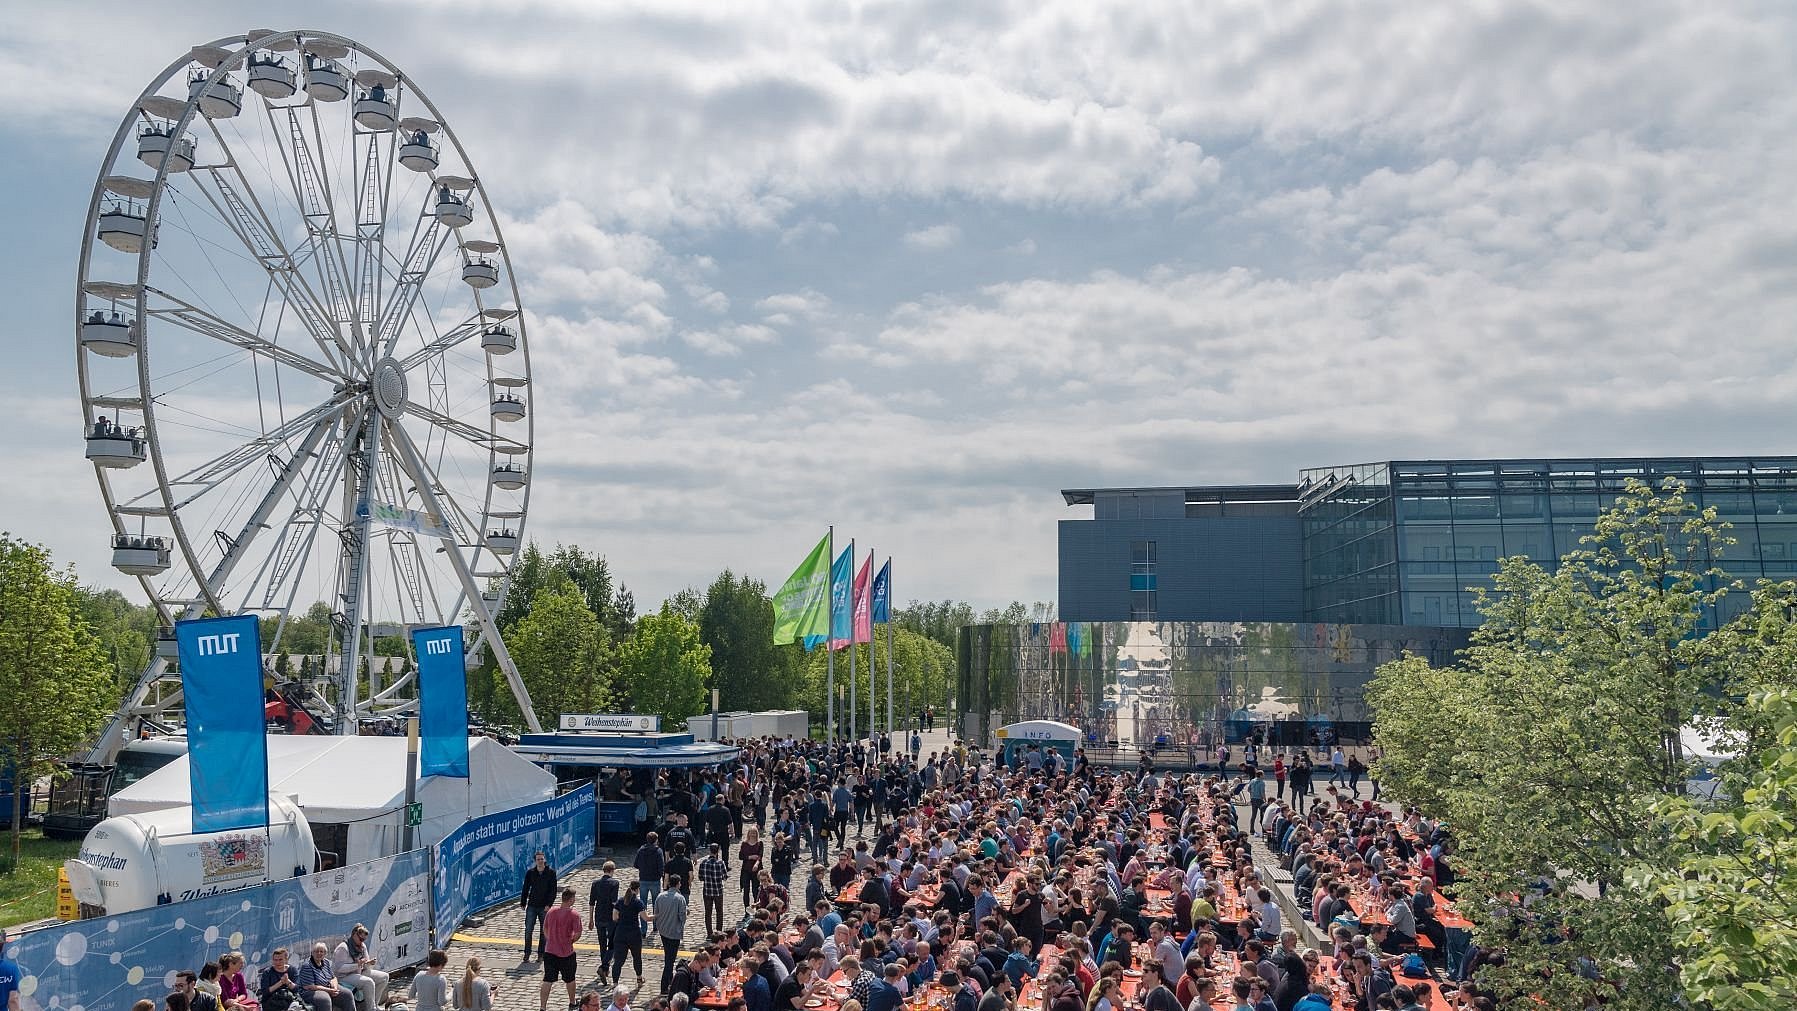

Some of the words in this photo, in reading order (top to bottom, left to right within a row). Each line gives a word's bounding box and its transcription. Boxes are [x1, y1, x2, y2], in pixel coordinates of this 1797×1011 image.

[1024, 731, 1052, 739] INFO
[475, 822, 495, 841] statt
[496, 820, 511, 834] nur
[512, 812, 545, 832] glotzen:
